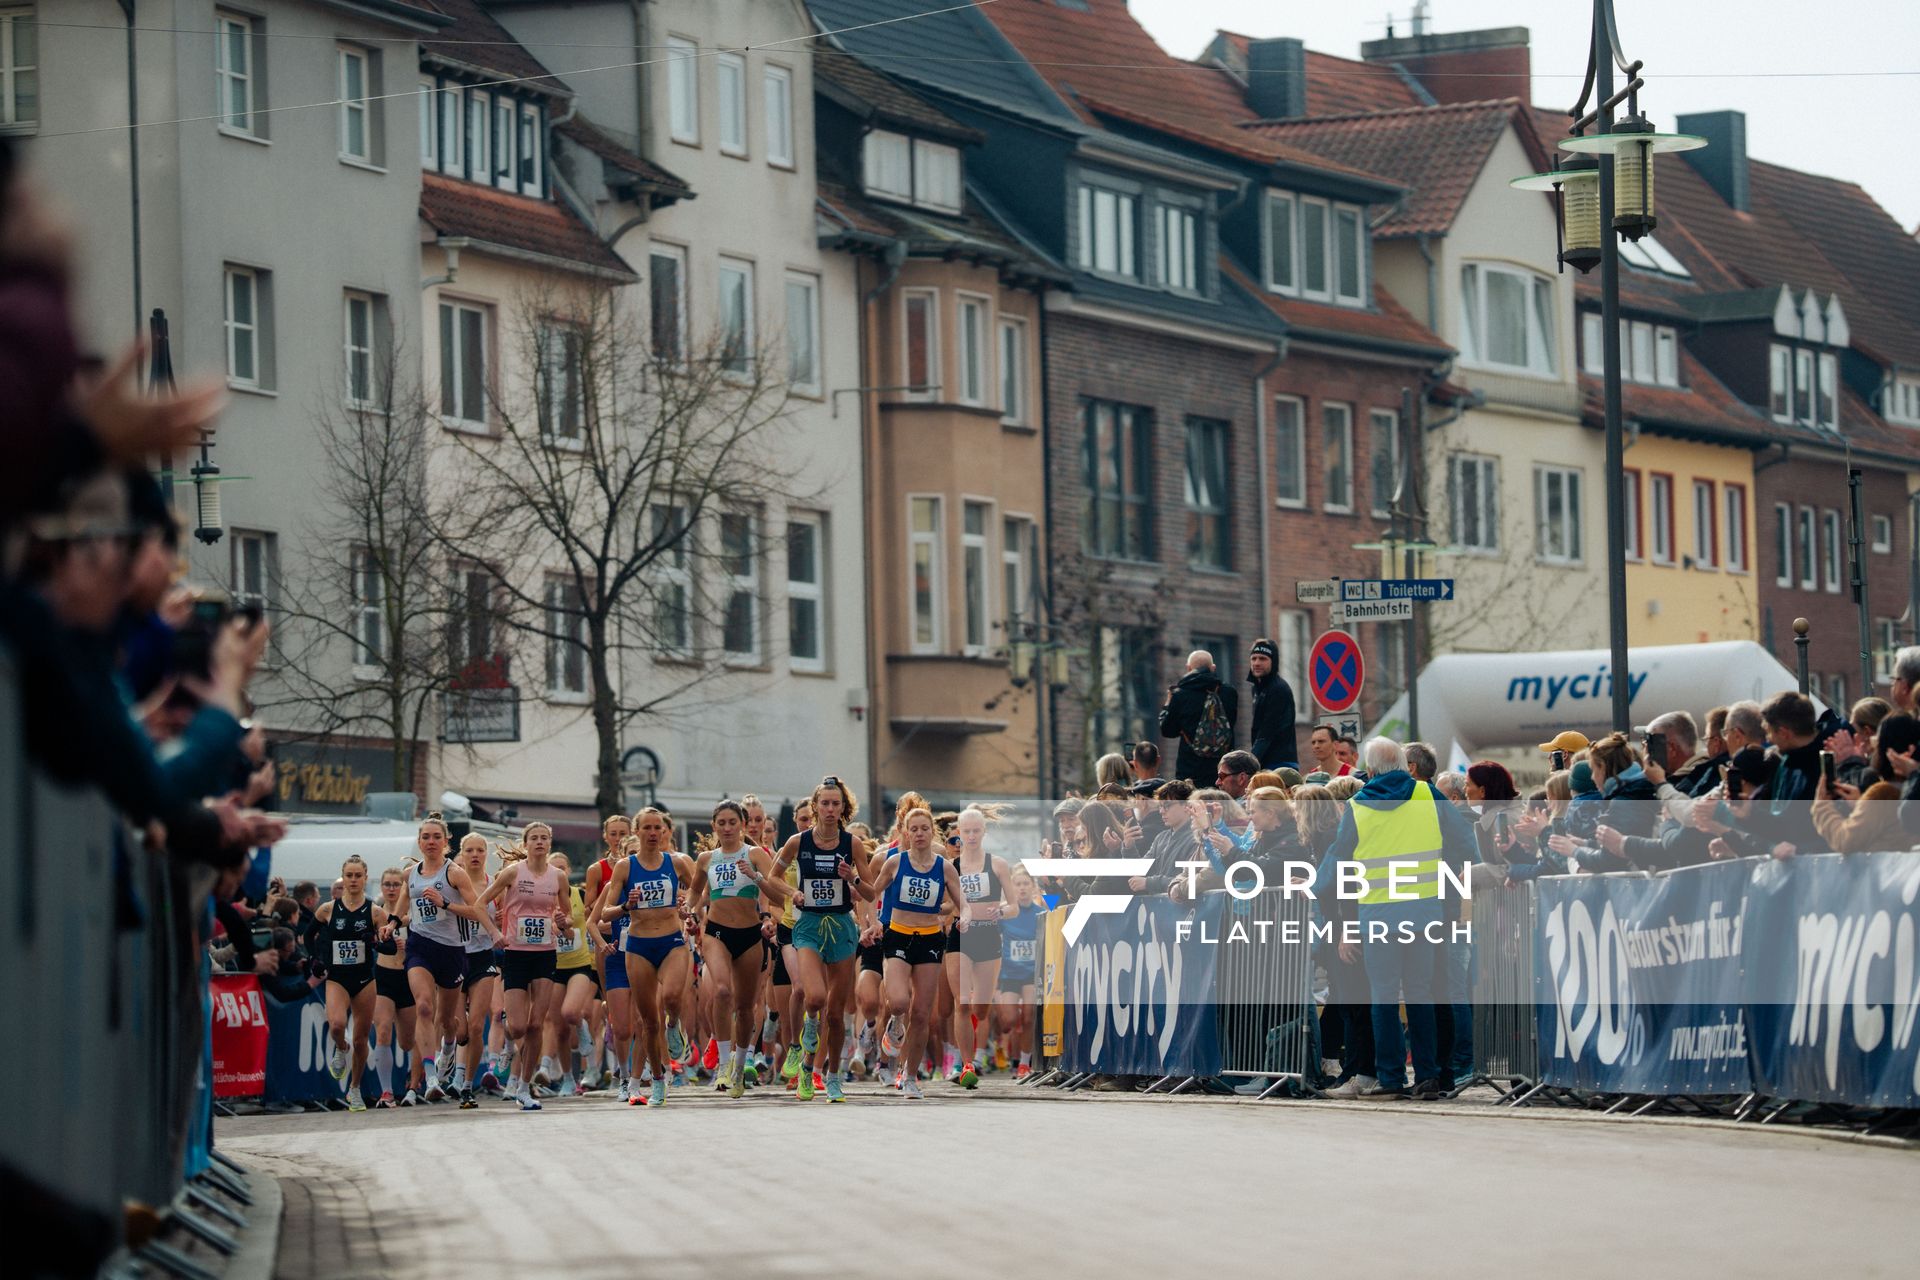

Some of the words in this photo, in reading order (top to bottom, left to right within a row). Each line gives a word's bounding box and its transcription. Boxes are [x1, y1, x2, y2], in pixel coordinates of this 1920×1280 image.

[1347, 585, 1361, 596] WC
[1388, 583, 1435, 597] Toiletten
[1346, 601, 1411, 618] Bahnhofstr.
[715, 862, 736, 872] GLS
[715, 870, 737, 882] 708
[961, 873, 980, 884] GLS
[642, 880, 664, 891] GLS
[811, 880, 833, 889] GLS
[909, 877, 931, 889] GLS
[962, 881, 981, 894] 291
[643, 889, 666, 902] 227
[812, 888, 835, 900] 659
[908, 886, 931, 900] 930
[418, 905, 438, 917] 180
[524, 918, 545, 928] GLS
[525, 927, 545, 938] 945
[338, 941, 357, 950] GLS
[339, 949, 358, 959] 974
[1074, 903, 1183, 1067] mycity
